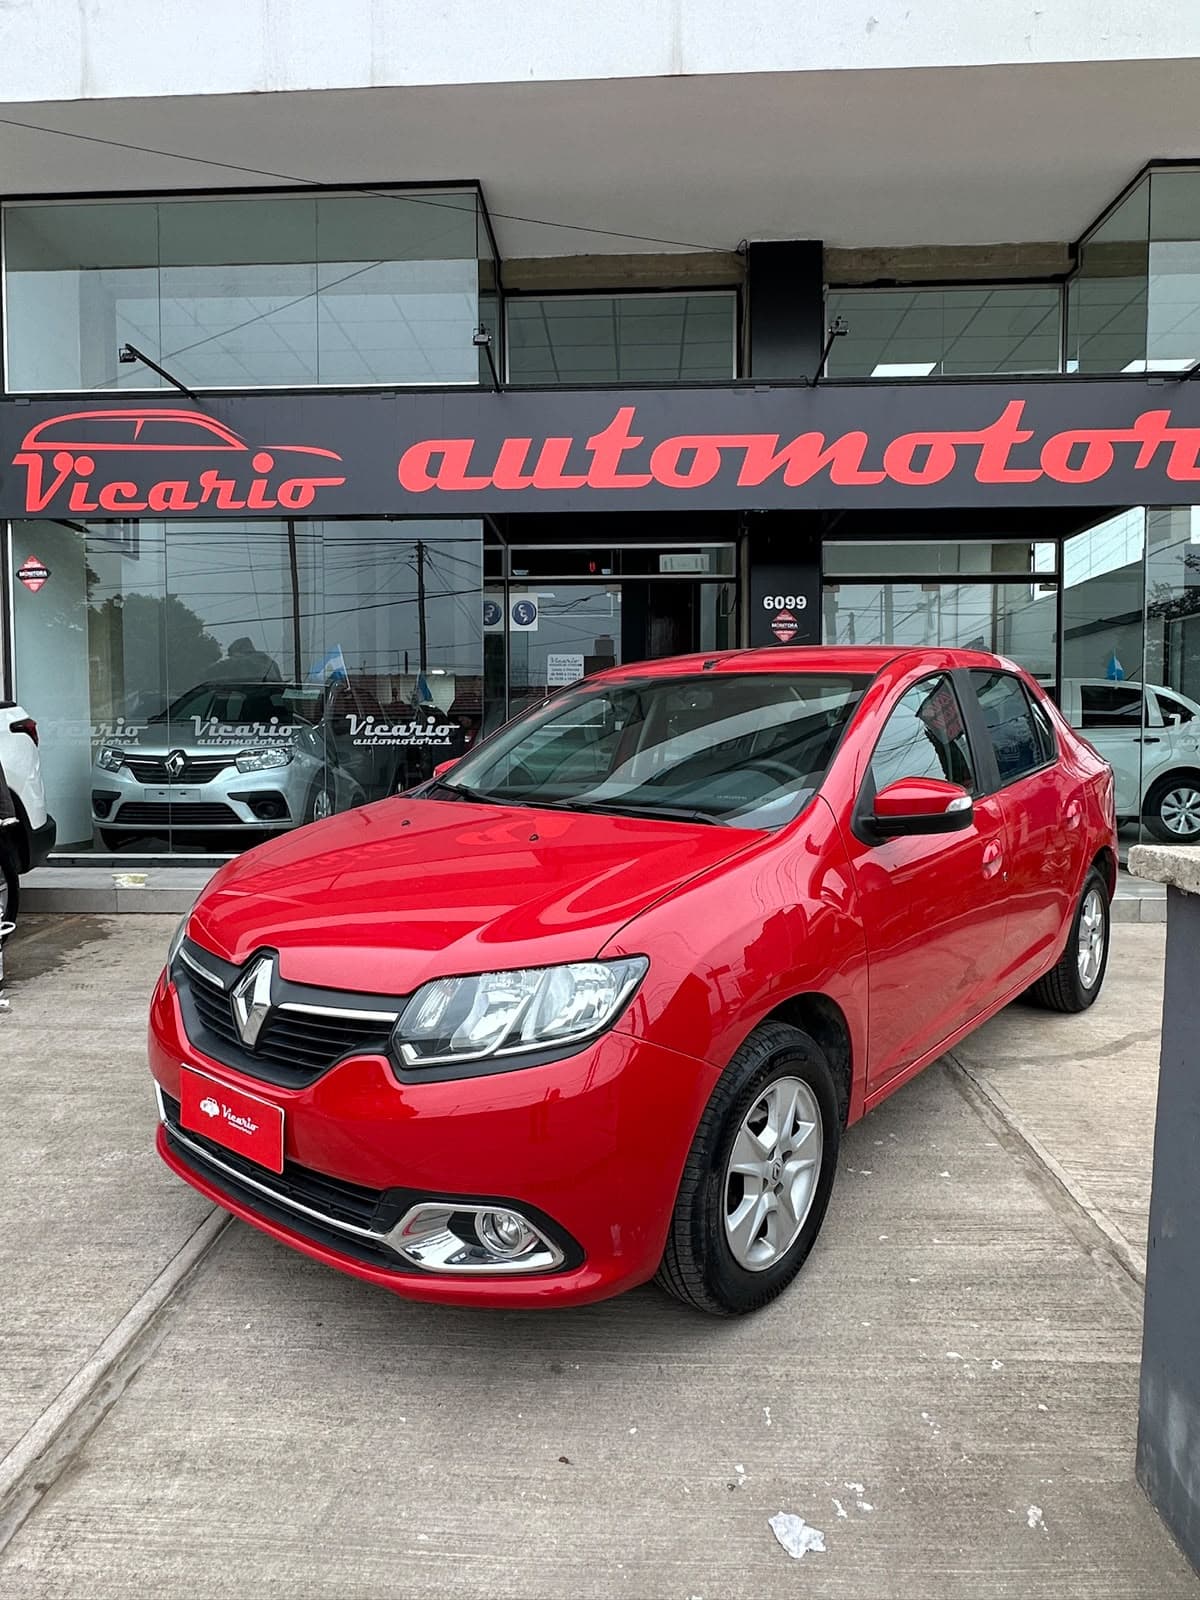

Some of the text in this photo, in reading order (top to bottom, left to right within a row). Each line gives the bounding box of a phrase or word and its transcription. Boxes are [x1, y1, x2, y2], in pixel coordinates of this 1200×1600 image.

[12, 450, 346, 512] Vicario
[763, 595, 807, 610] 6099
[190, 715, 303, 736] Vicario
[345, 714, 460, 736] Vicario
[197, 734, 295, 746] automotores
[352, 735, 453, 746] automotores
[221, 1103, 260, 1132] Vicario
